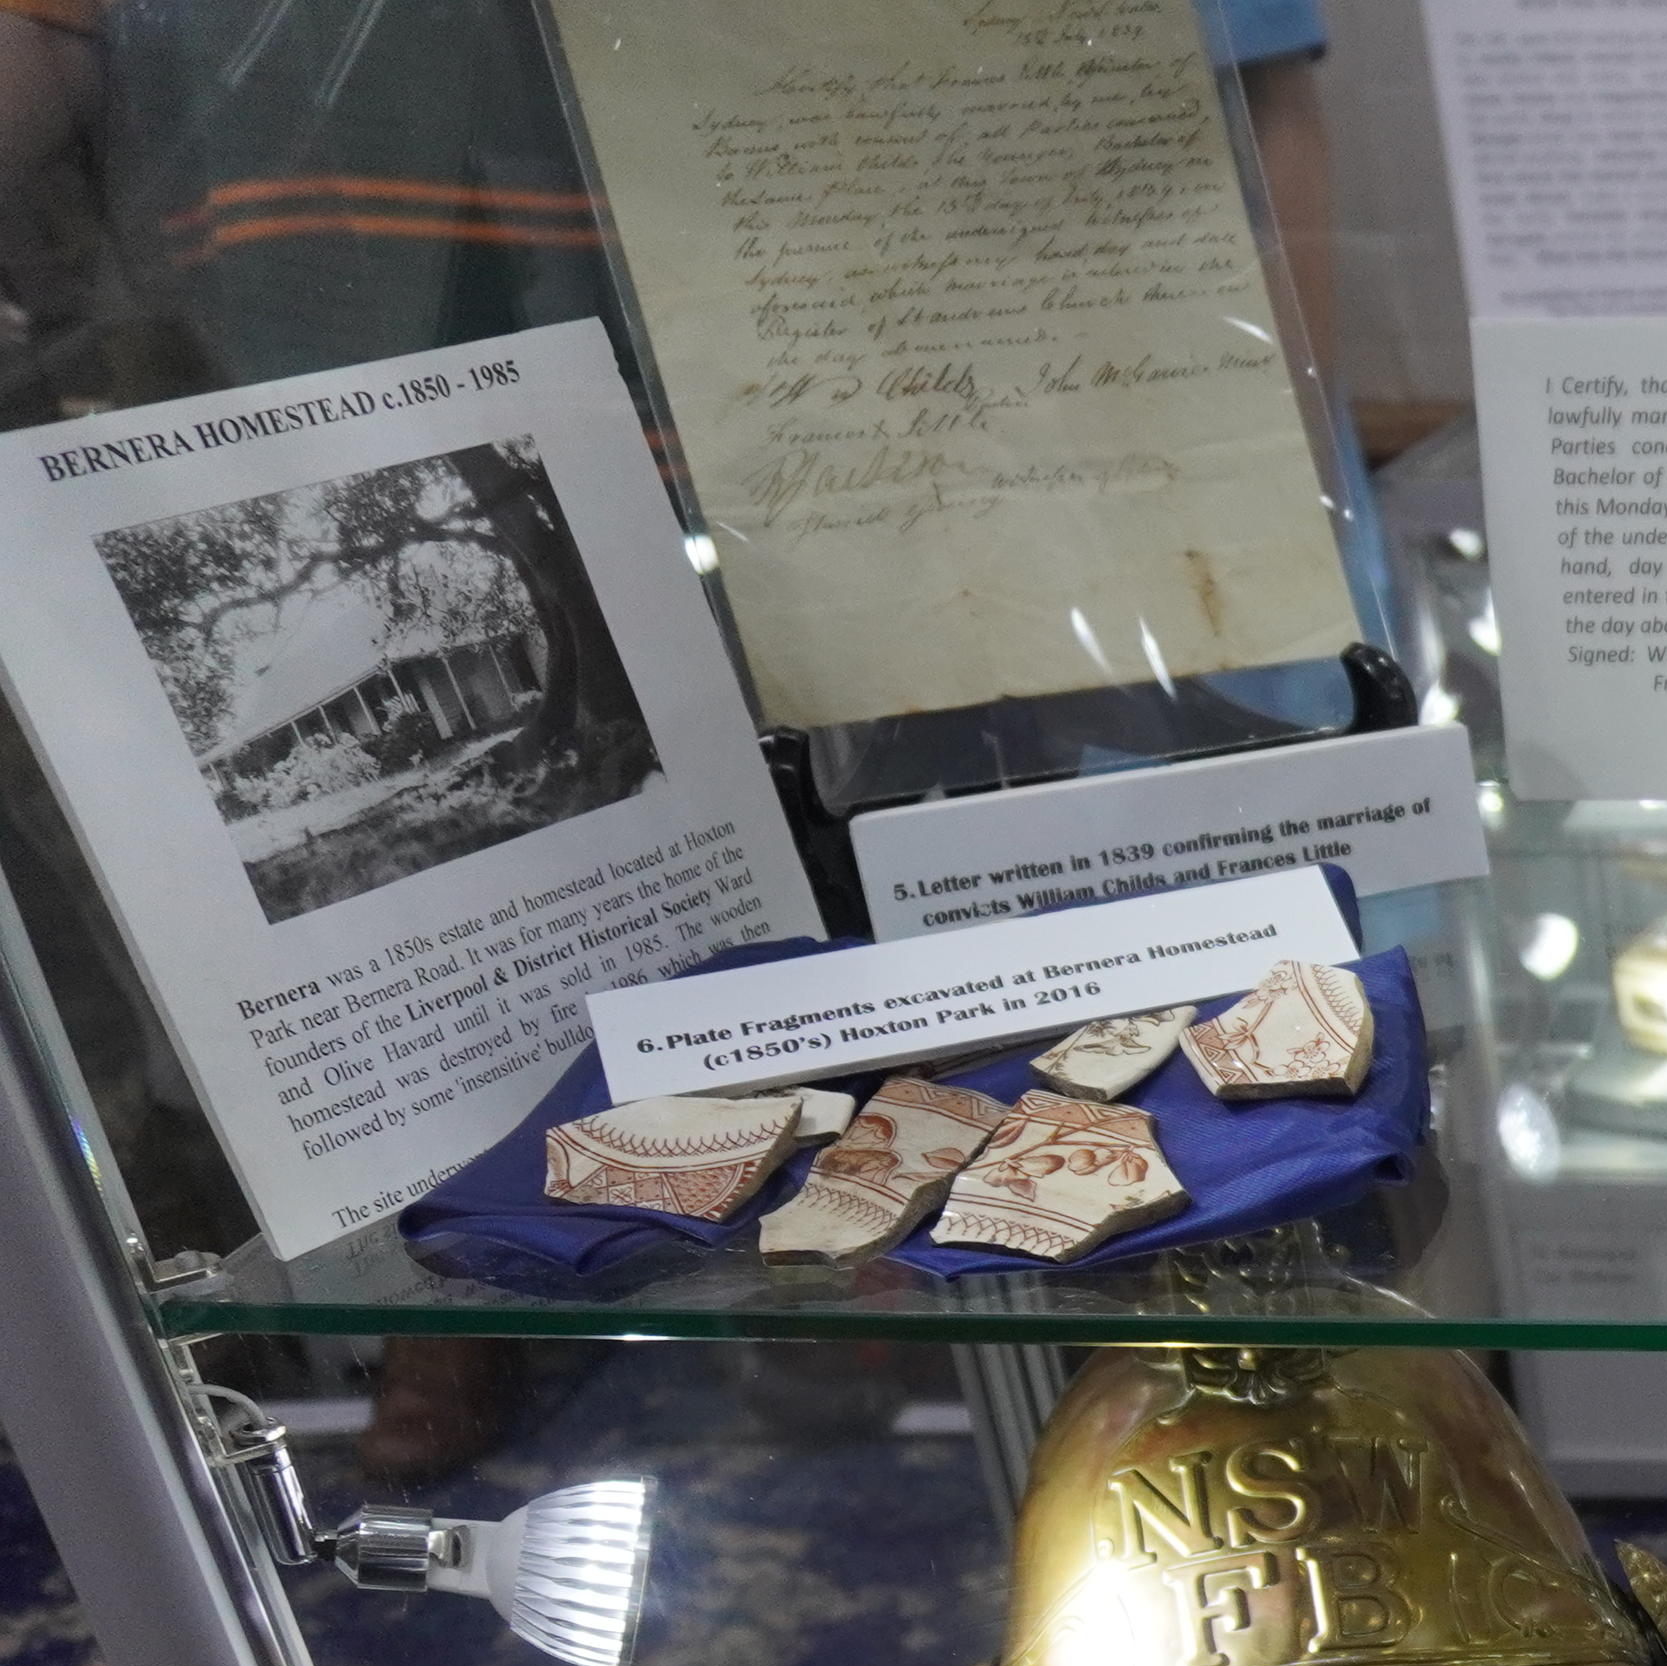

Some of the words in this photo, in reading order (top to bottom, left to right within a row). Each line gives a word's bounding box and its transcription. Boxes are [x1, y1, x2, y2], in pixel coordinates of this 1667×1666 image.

[39, 430, 195, 482] BERNERA
[193, 391, 376, 449] HOMESTEAD
[381, 374, 451, 410] c.1850
[468, 359, 520, 391] 1985
[1561, 375, 1629, 398] Certify,
[987, 861, 1064, 885] written
[1070, 855, 1092, 872] in
[1098, 843, 1155, 867] 1839
[1162, 824, 1275, 857] confirming
[1278, 819, 1311, 838] the
[1316, 804, 1406, 831] marriage
[1411, 796, 1431, 815] of
[235, 980, 322, 1021] Bernera
[325, 964, 364, 988] was
[368, 958, 382, 974] a
[384, 935, 435, 966] 1850s
[438, 917, 485, 946] estate
[488, 899, 520, 927] and
[521, 867, 606, 913] homestead
[607, 845, 665, 881] located
[668, 841, 683, 859] at
[683, 821, 736, 852] Hoxton
[703, 1032, 832, 1071] (c1850's)
[839, 1017, 929, 1043] Hoxton
[935, 1002, 996, 1024] Park
[1002, 998, 1027, 1012] in
[1033, 981, 1101, 1006] 2016
[739, 1002, 876, 1037] Fragments
[883, 975, 1005, 1010] excavated
[1012, 969, 1037, 986] at
[1042, 953, 1142, 980] Bernera
[1147, 923, 1278, 960] Homestead
[1108, 1434, 1428, 1570] NSW
